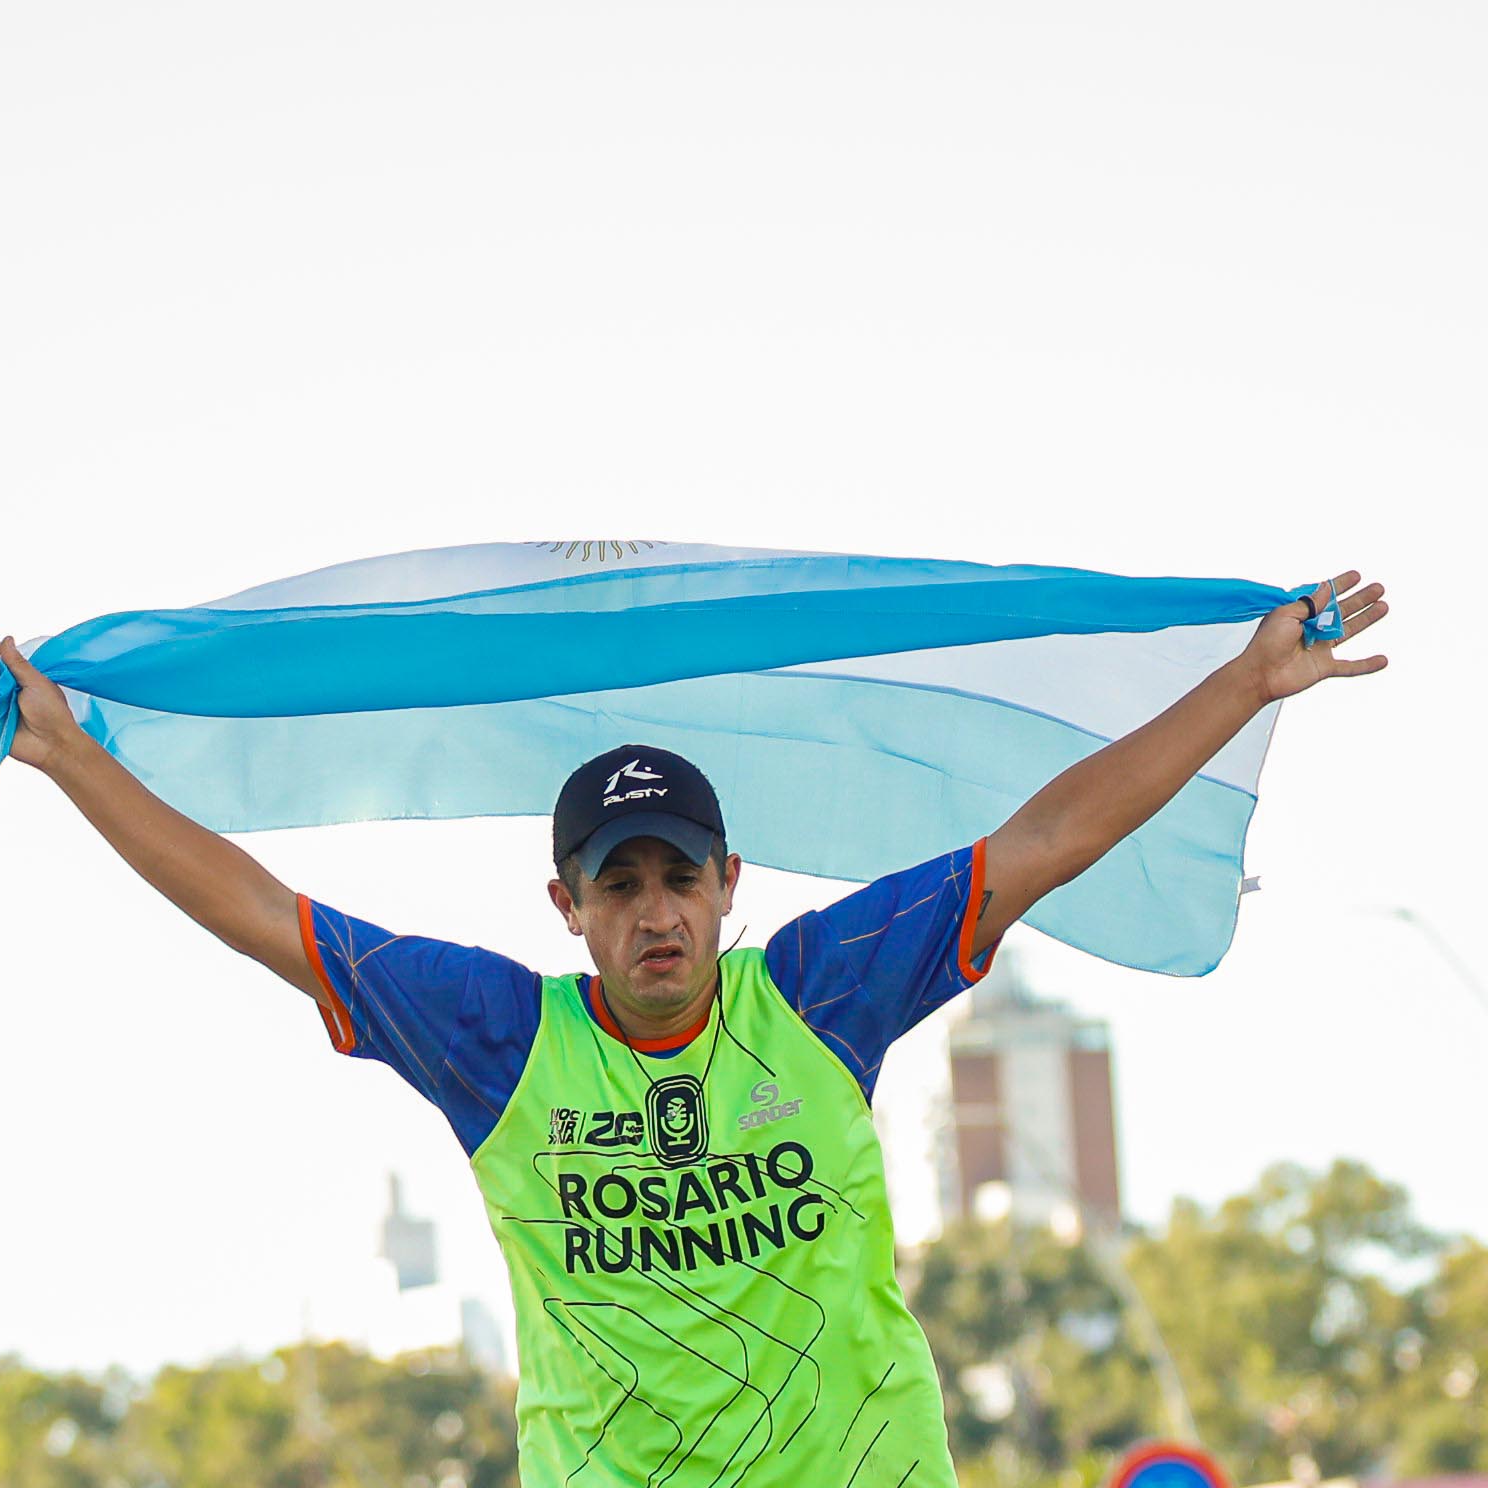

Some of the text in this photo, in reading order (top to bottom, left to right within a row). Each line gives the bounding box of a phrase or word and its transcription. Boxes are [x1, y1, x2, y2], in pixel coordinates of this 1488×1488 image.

[603, 788, 668, 807] RUSTY
[558, 1141, 813, 1221] ROSARIO
[565, 1193, 825, 1274] RUNNING
